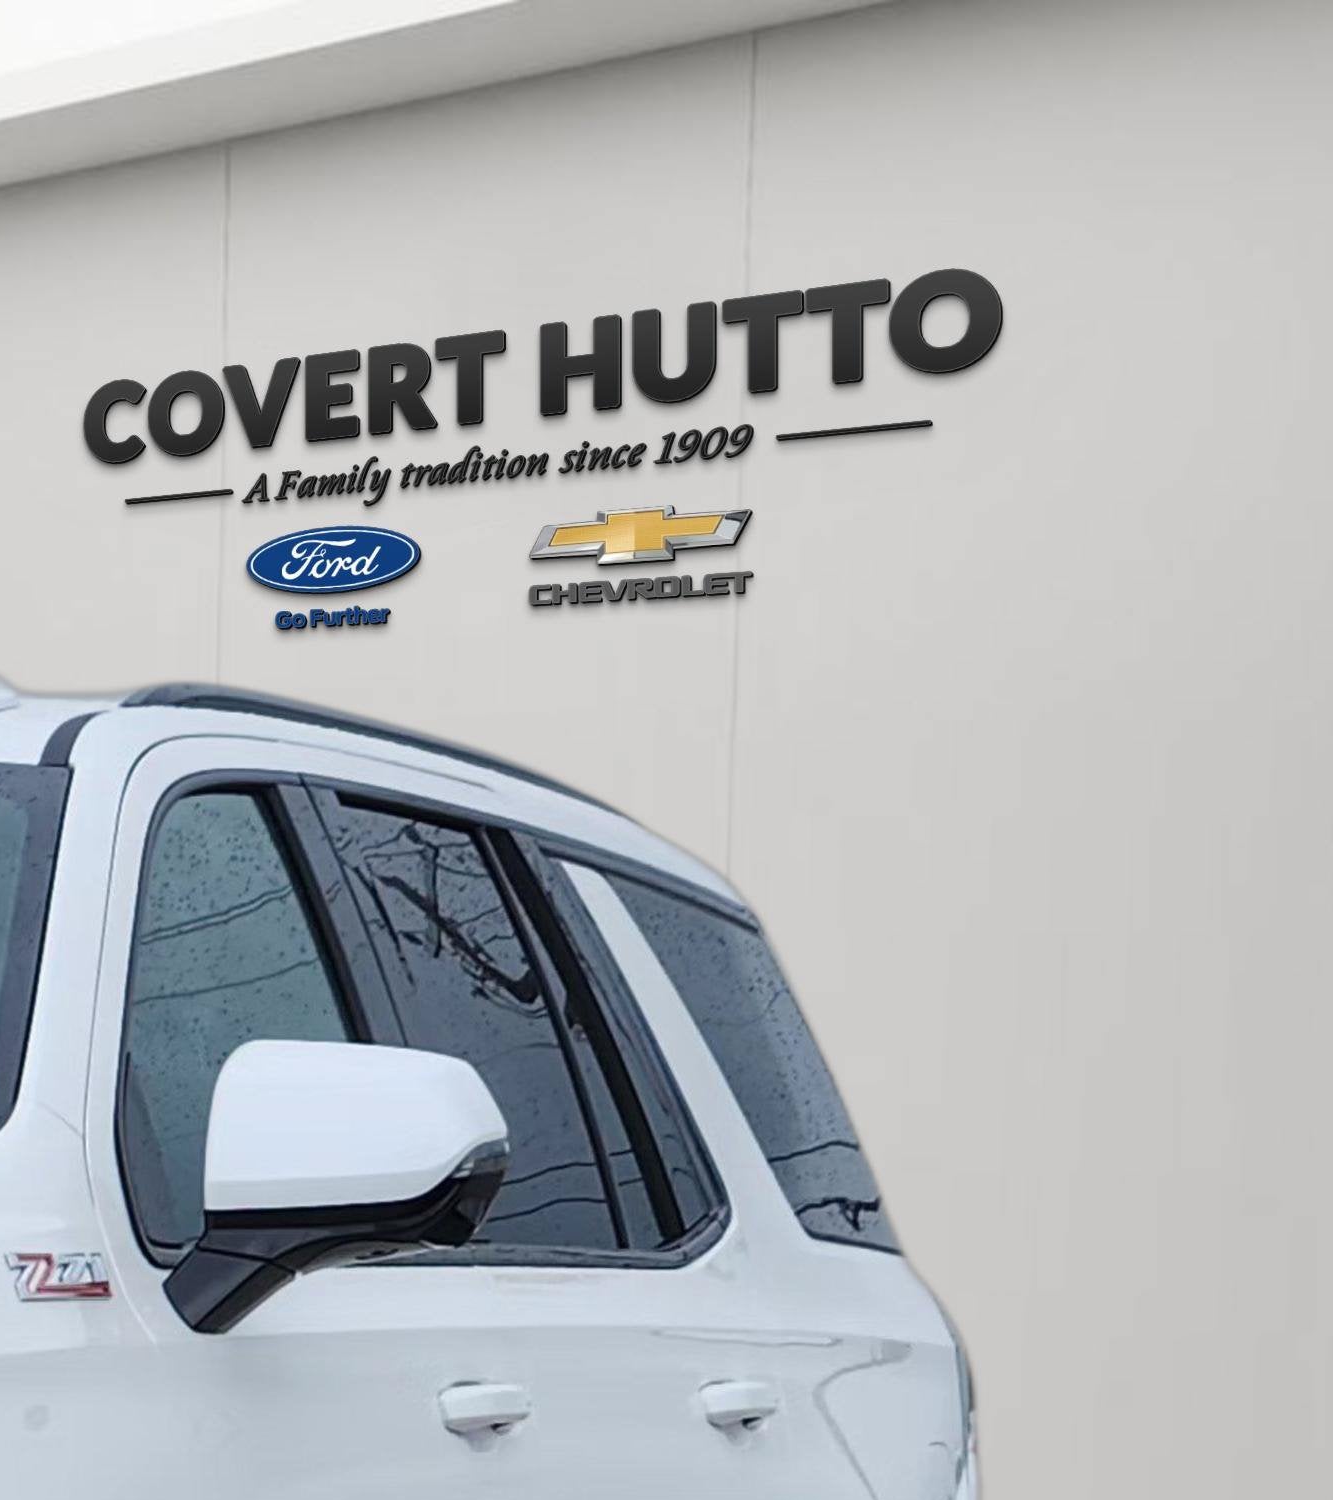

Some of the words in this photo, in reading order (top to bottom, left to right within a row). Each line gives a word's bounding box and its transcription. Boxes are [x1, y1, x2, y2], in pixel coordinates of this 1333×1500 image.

[84, 330, 506, 466] COVERT
[540, 269, 1003, 418] HUTTO
[241, 472, 270, 505] A
[273, 456, 391, 507] Family
[400, 445, 549, 490] tradition
[558, 441, 648, 475] since
[653, 423, 755, 466] 1909
[281, 537, 380, 580] Ford
[529, 571, 755, 608] CHEVROLET
[275, 608, 308, 631] Go
[310, 605, 391, 629] Further
